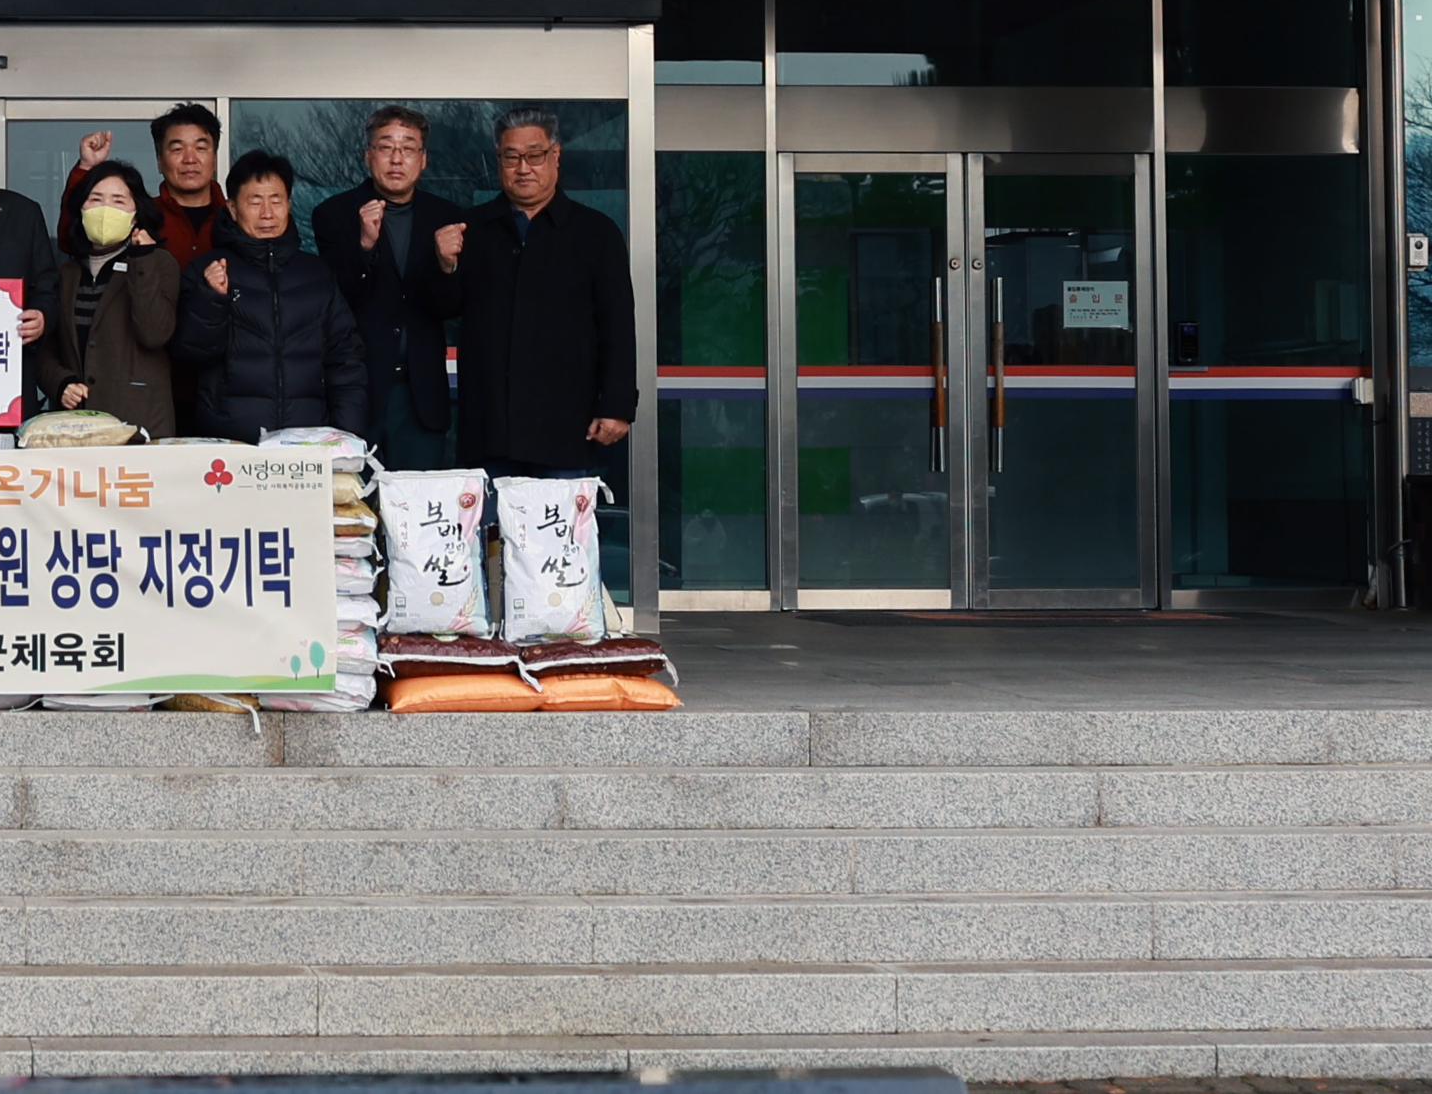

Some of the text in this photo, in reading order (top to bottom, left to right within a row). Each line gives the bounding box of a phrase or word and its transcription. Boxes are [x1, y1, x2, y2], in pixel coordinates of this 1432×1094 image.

[237, 459, 285, 481] 사랑의
[45, 527, 123, 610] 상당
[139, 526, 296, 609] 지정기탁
